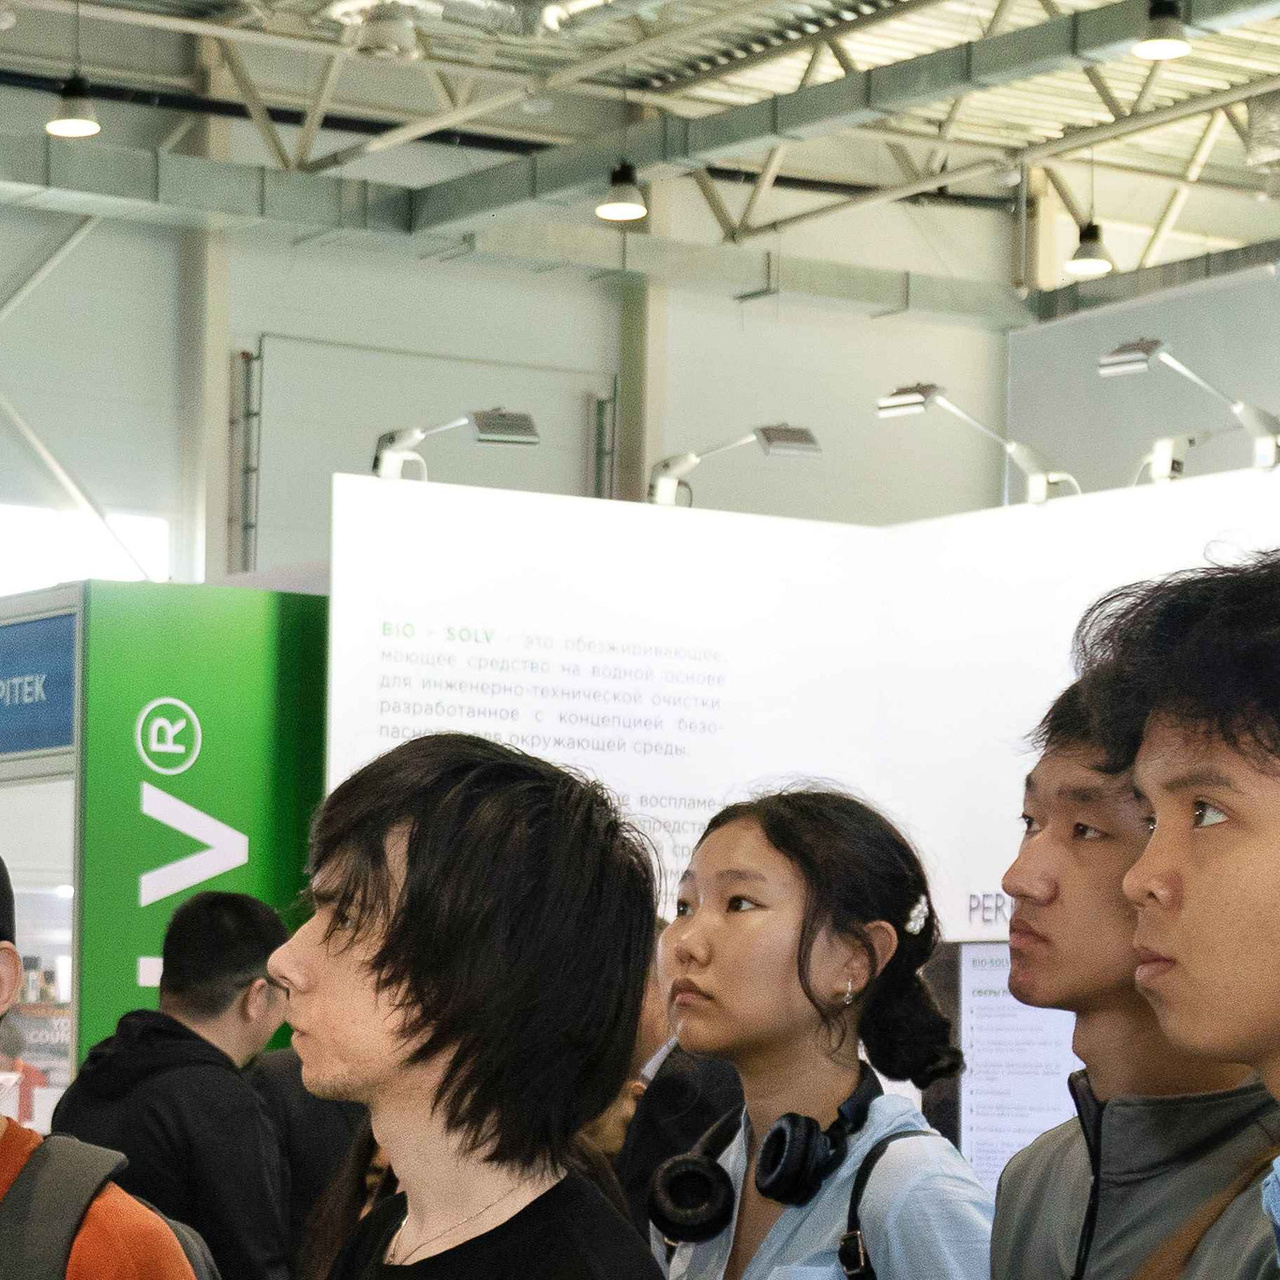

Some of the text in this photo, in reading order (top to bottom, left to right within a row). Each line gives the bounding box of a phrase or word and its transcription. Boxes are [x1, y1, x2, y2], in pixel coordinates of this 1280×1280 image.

[381, 620, 416, 639] BIO
[446, 625, 496, 644] SOLV
[378, 674, 413, 690] для
[380, 649, 726, 687] моющее средство на водной основе
[380, 698, 521, 722] разработанное
[558, 711, 664, 731] концепцией
[968, 892, 1017, 924] PER
